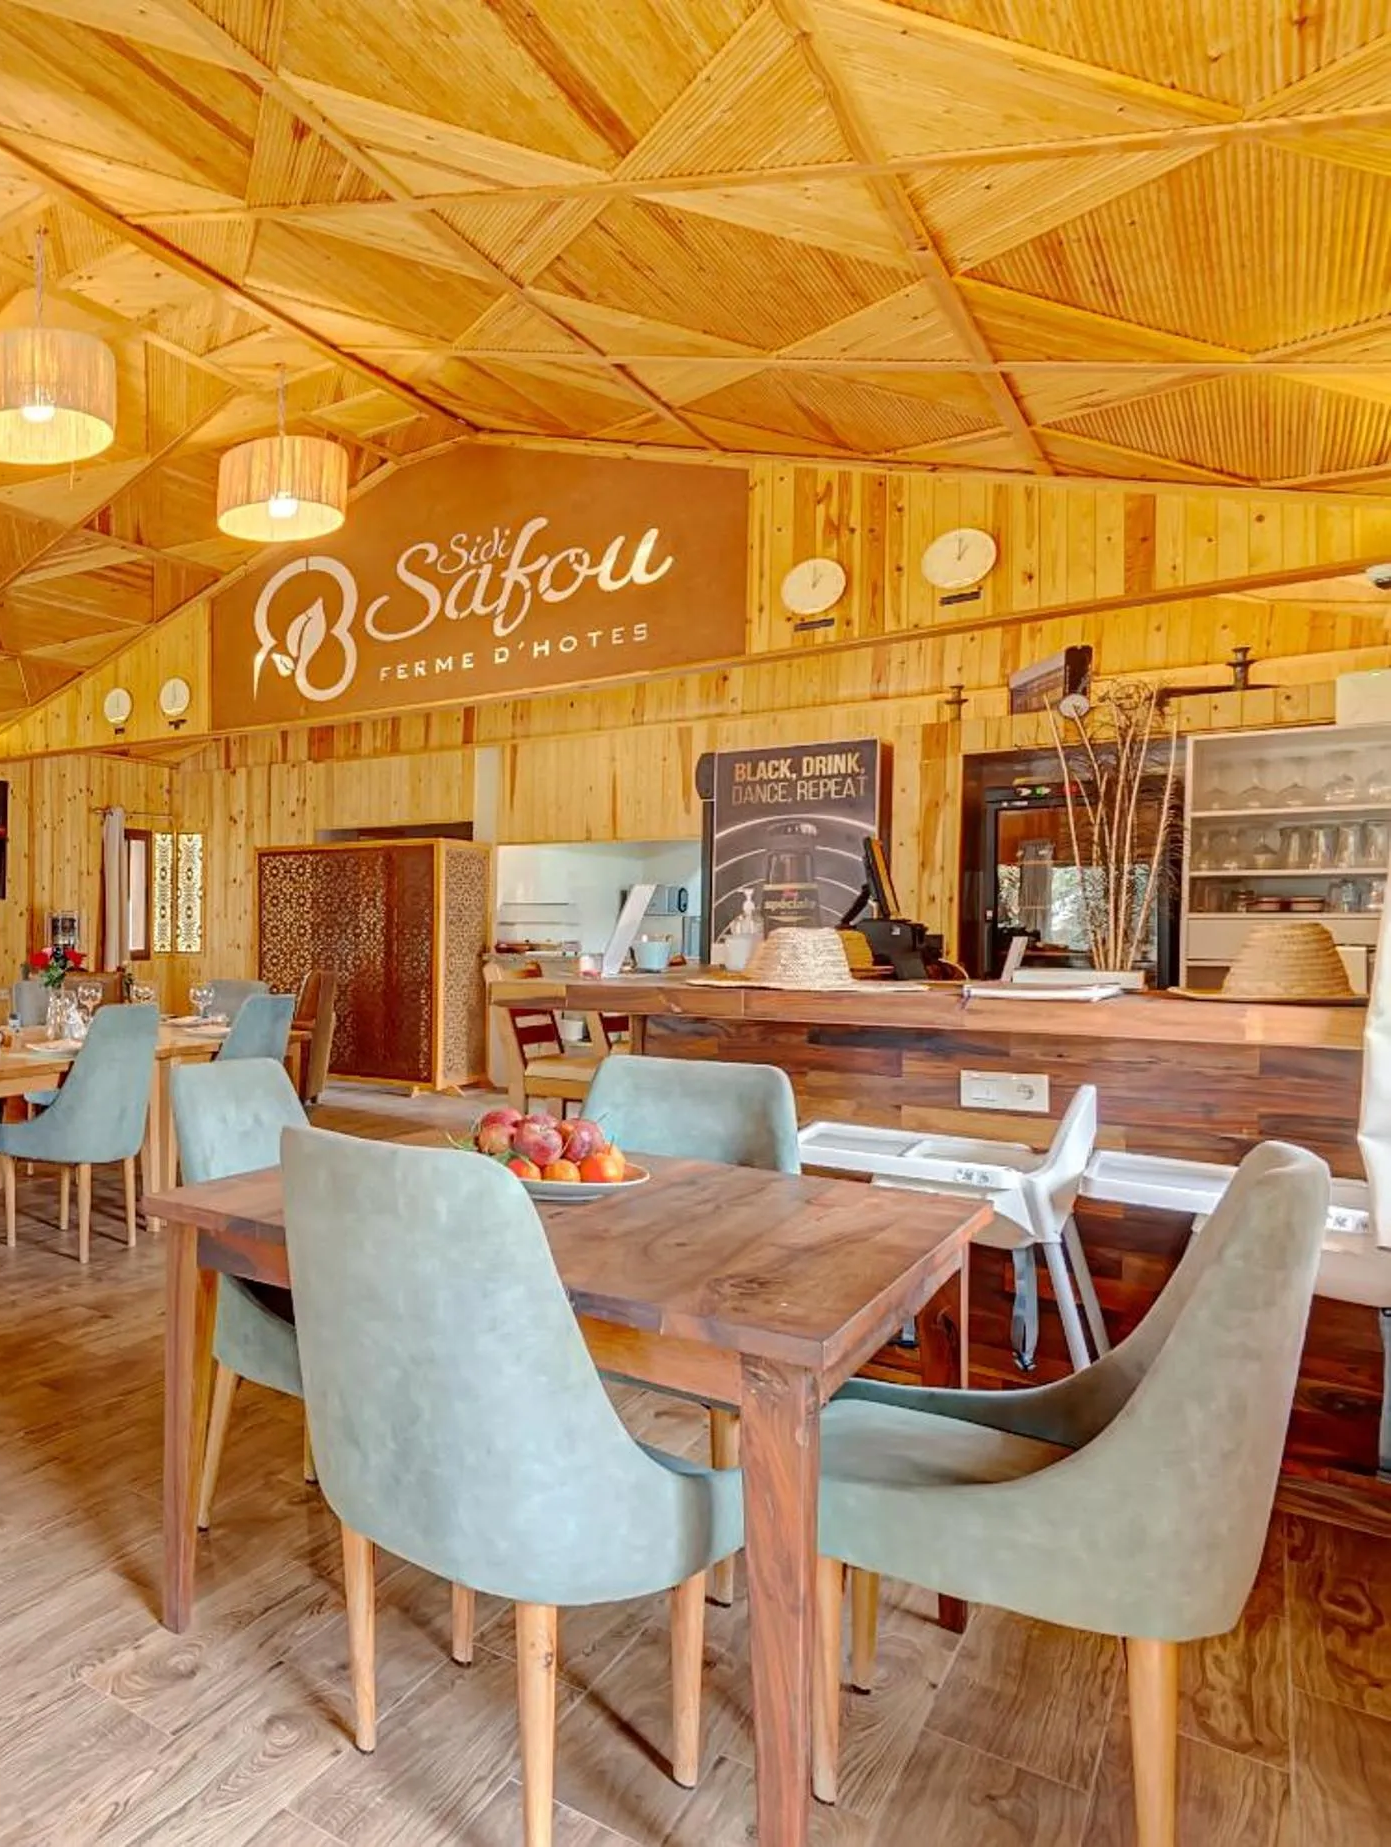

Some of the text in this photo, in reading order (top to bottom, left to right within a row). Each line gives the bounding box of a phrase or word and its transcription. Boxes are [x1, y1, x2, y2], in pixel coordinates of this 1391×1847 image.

[437, 527, 511, 574] Sidi
[364, 517, 674, 642] Safou
[379, 623, 648, 682] FERME D'HOTES
[734, 758, 797, 782] BLACK,
[797, 775, 868, 802] REPEAT
